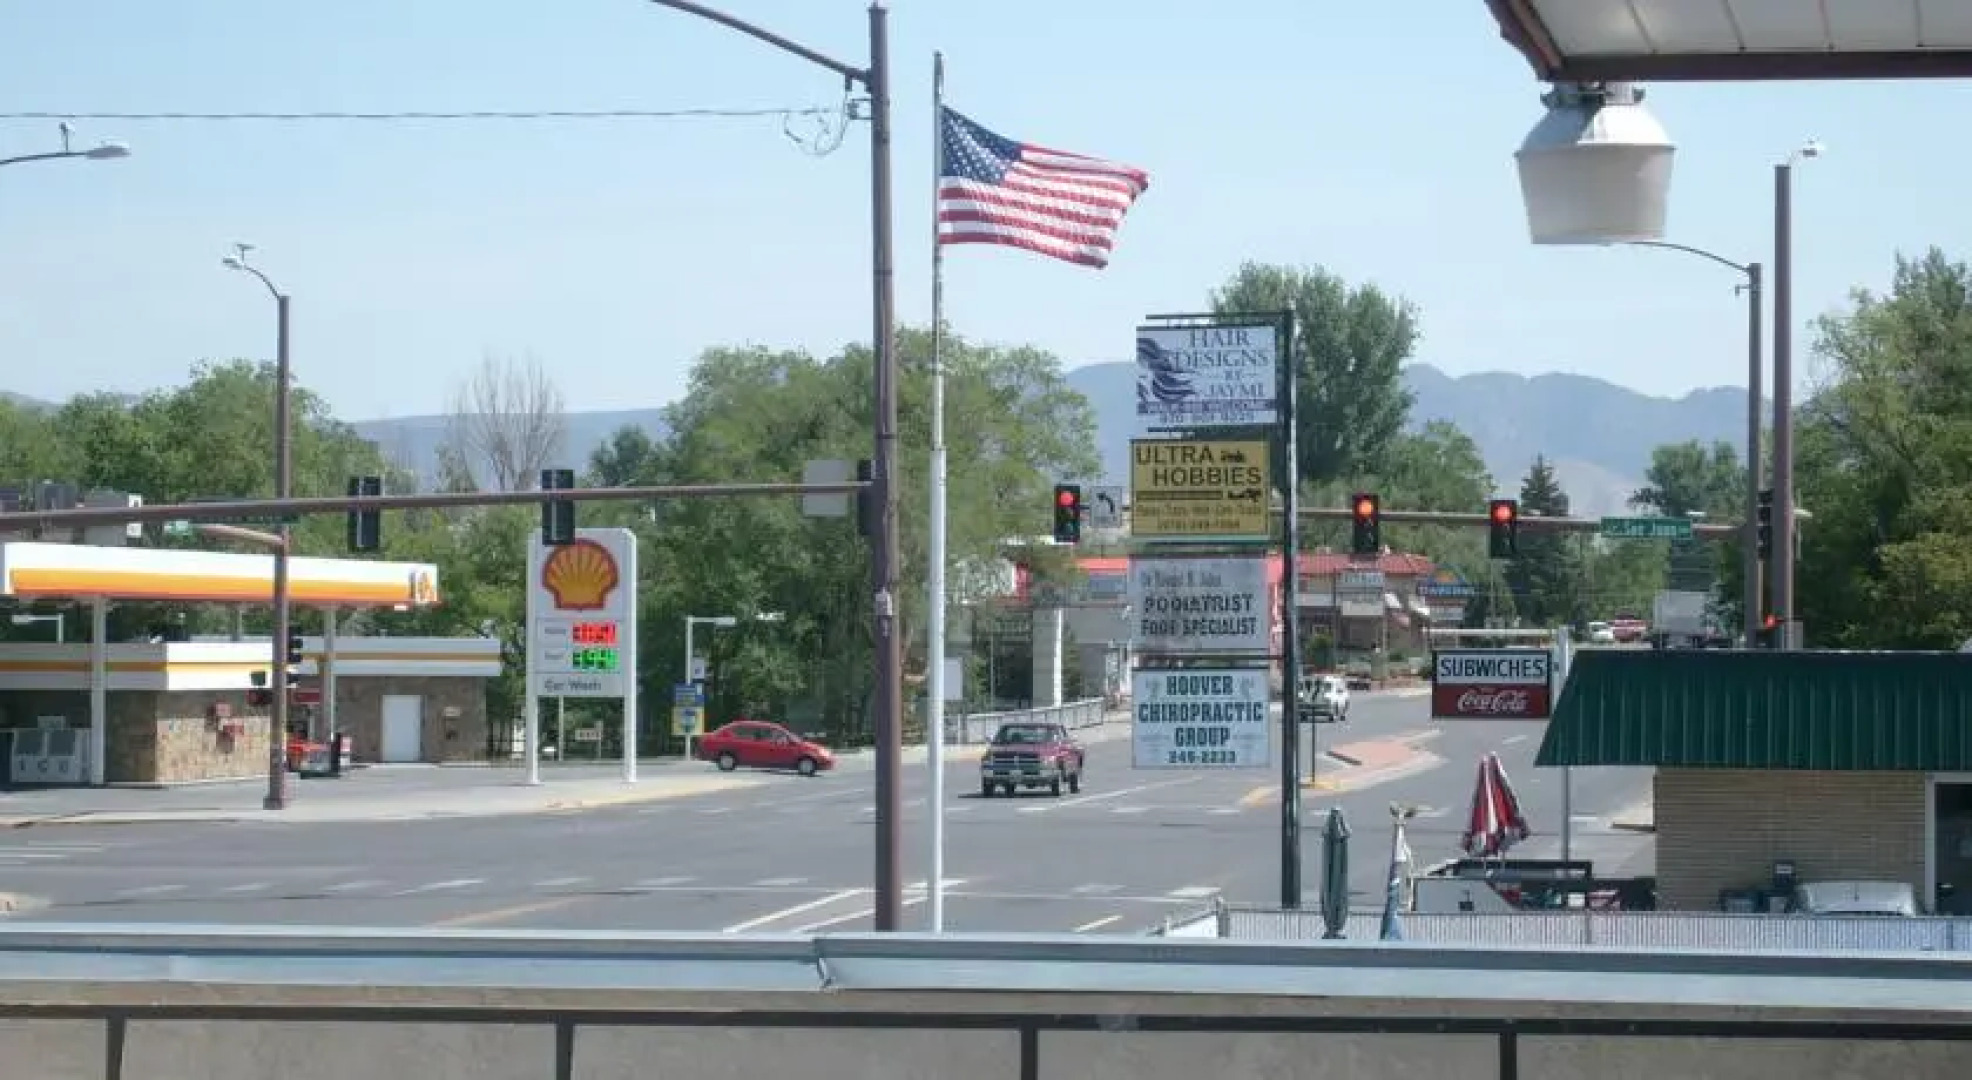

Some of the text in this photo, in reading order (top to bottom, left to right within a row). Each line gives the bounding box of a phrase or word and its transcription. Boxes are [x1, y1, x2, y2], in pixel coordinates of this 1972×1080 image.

[1189, 329, 1250, 347] HAIR
[1174, 350, 1269, 367] DESIGNS
[1136, 445, 1214, 464] ULTRA
[1153, 467, 1262, 487] HOBBIES
[1145, 594, 1255, 613] PODIATRIST
[1140, 617, 1257, 636] FOOT SPECIALIST
[1441, 657, 1543, 677] SUBWICHES
[1166, 675, 1233, 695] HOOVER
[1138, 702, 1264, 723] CHIROPRACTIC
[1174, 727, 1231, 747] GROUP
